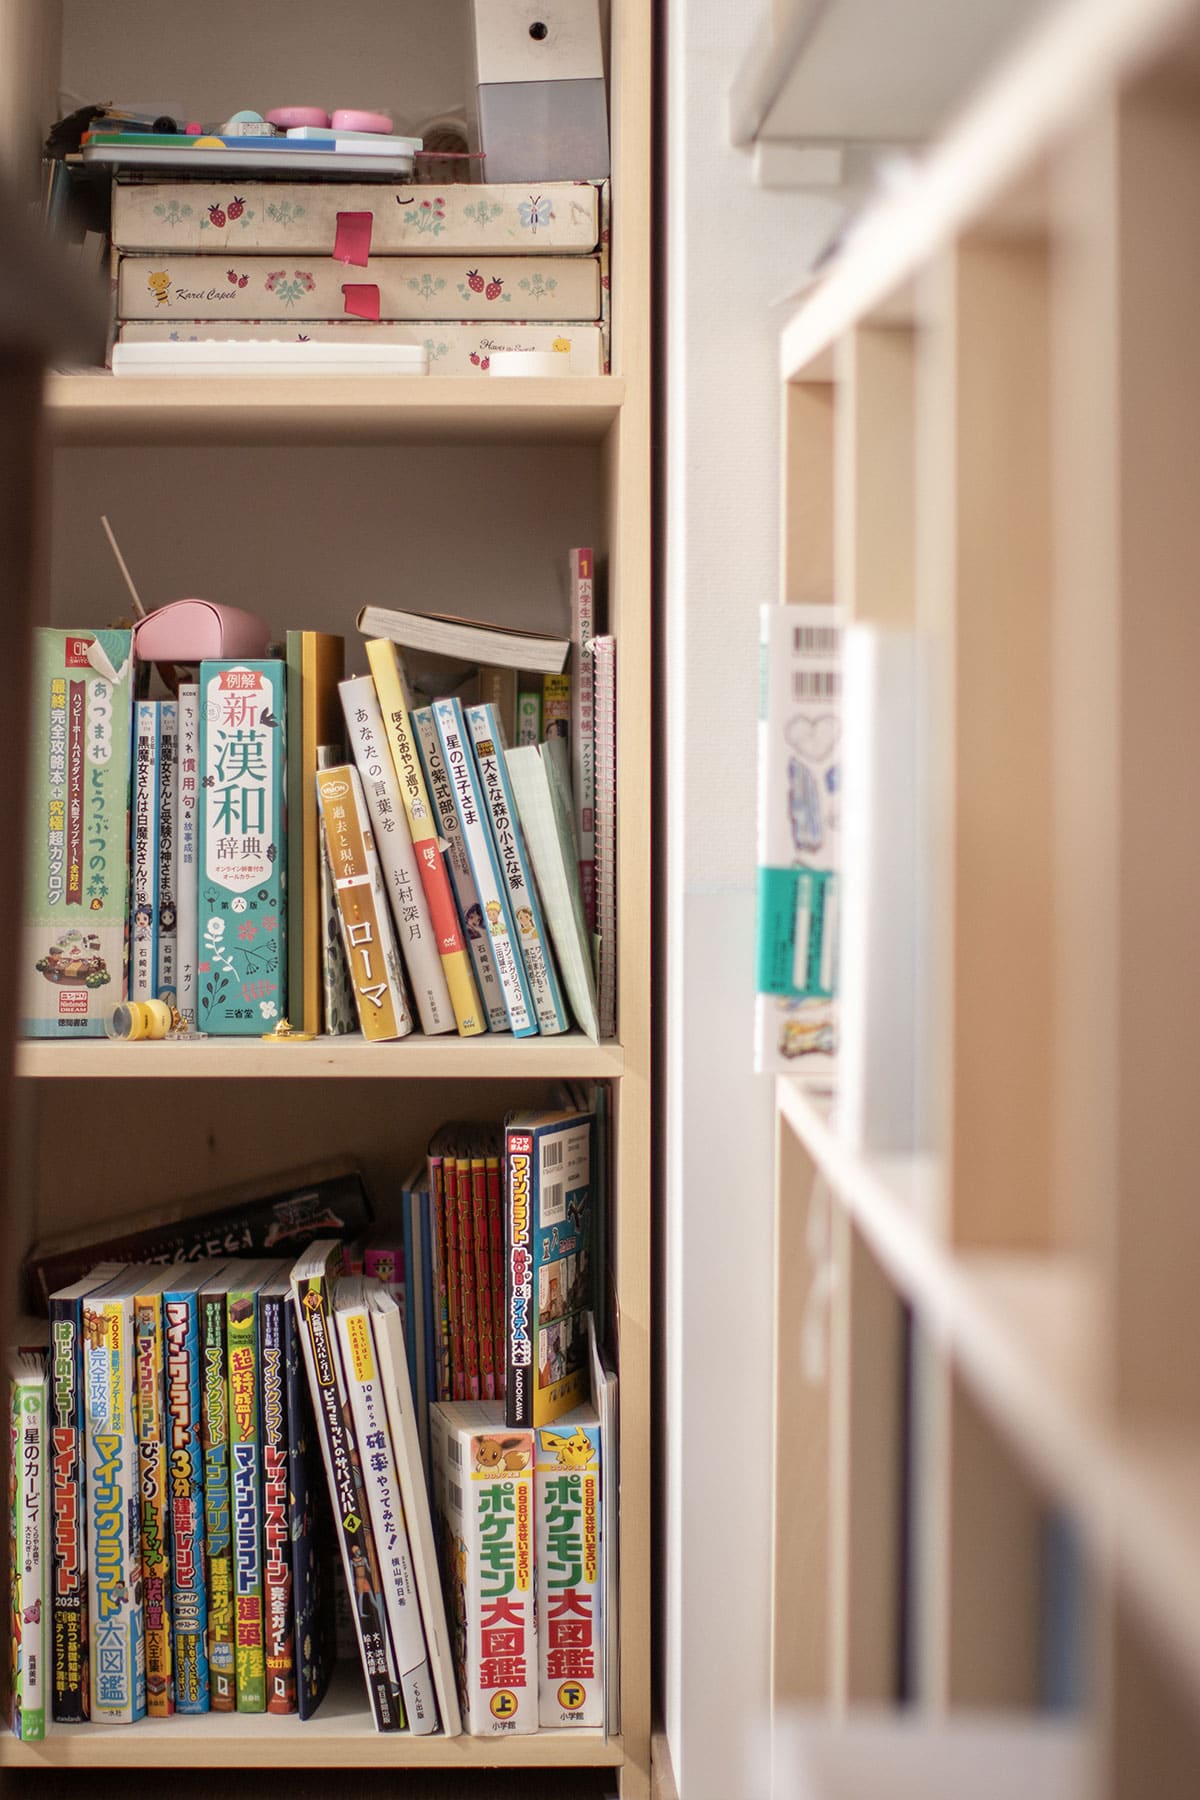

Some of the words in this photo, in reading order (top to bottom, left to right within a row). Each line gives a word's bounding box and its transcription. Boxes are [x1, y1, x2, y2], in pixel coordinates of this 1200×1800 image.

[175, 288, 203, 301] Karel
[581, 560, 588, 577] 1
[226, 673, 256, 688] 例解
[92, 682, 108, 760] あつまれ
[185, 707, 193, 753] ちいかわ
[354, 708, 396, 832] あなたの言葉を
[392, 710, 420, 797] ぼくのおやつ巡り
[446, 734, 478, 825] 星の王子さま
[216, 837, 263, 859] 辞典
[333, 805, 355, 876] 過去と現在
[482, 758, 525, 889] 大きな森の小さな家
[423, 846, 436, 870] ぼく
[393, 869, 422, 940] 辻村深月
[184, 964, 192, 991] ナガノ
[347, 922, 388, 1007] ローマ
[225, 1009, 253, 1018] 三省堂
[513, 1156, 528, 1243] マインクラフト
[513, 1250, 526, 1285] MOB
[514, 1287, 524, 1297] &
[111, 1315, 119, 1349] 2023
[512, 1299, 526, 1341] アイテム
[166, 1303, 190, 1449] マインクラフト
[513, 1342, 526, 1364] 大全
[140, 1339, 154, 1438] マインクラフト
[207, 1350, 221, 1443] マインクラフト
[232, 1348, 254, 1443] 超特盛り!
[265, 1350, 280, 1444] マインクラフト
[515, 1369, 523, 1421] KADOKAWA
[24, 1428, 40, 1522] 星のカービィ
[140, 1441, 158, 1499] びっくり
[323, 1388, 356, 1514] ピラミッドのサバイバル
[54, 1428, 77, 1595] マインクラフト
[94, 1436, 122, 1621] マインクラフト
[207, 1444, 230, 1555] インテリア
[235, 1445, 257, 1594] マインクラフト
[264, 1446, 287, 1583] レッドストーン
[56, 1597, 80, 1606] 2025
[237, 1597, 260, 1647] 建築
[271, 1587, 285, 1656] 完全ガイド
[98, 1621, 124, 1701] 大図鑑
[238, 1651, 249, 1691] ガイド
[250, 1651, 263, 1678] 完全
[492, 1721, 517, 1730] 小学館
[496, 1695, 512, 1712] 上
[560, 1711, 585, 1721] 小学館
[564, 1688, 580, 1705] 下
